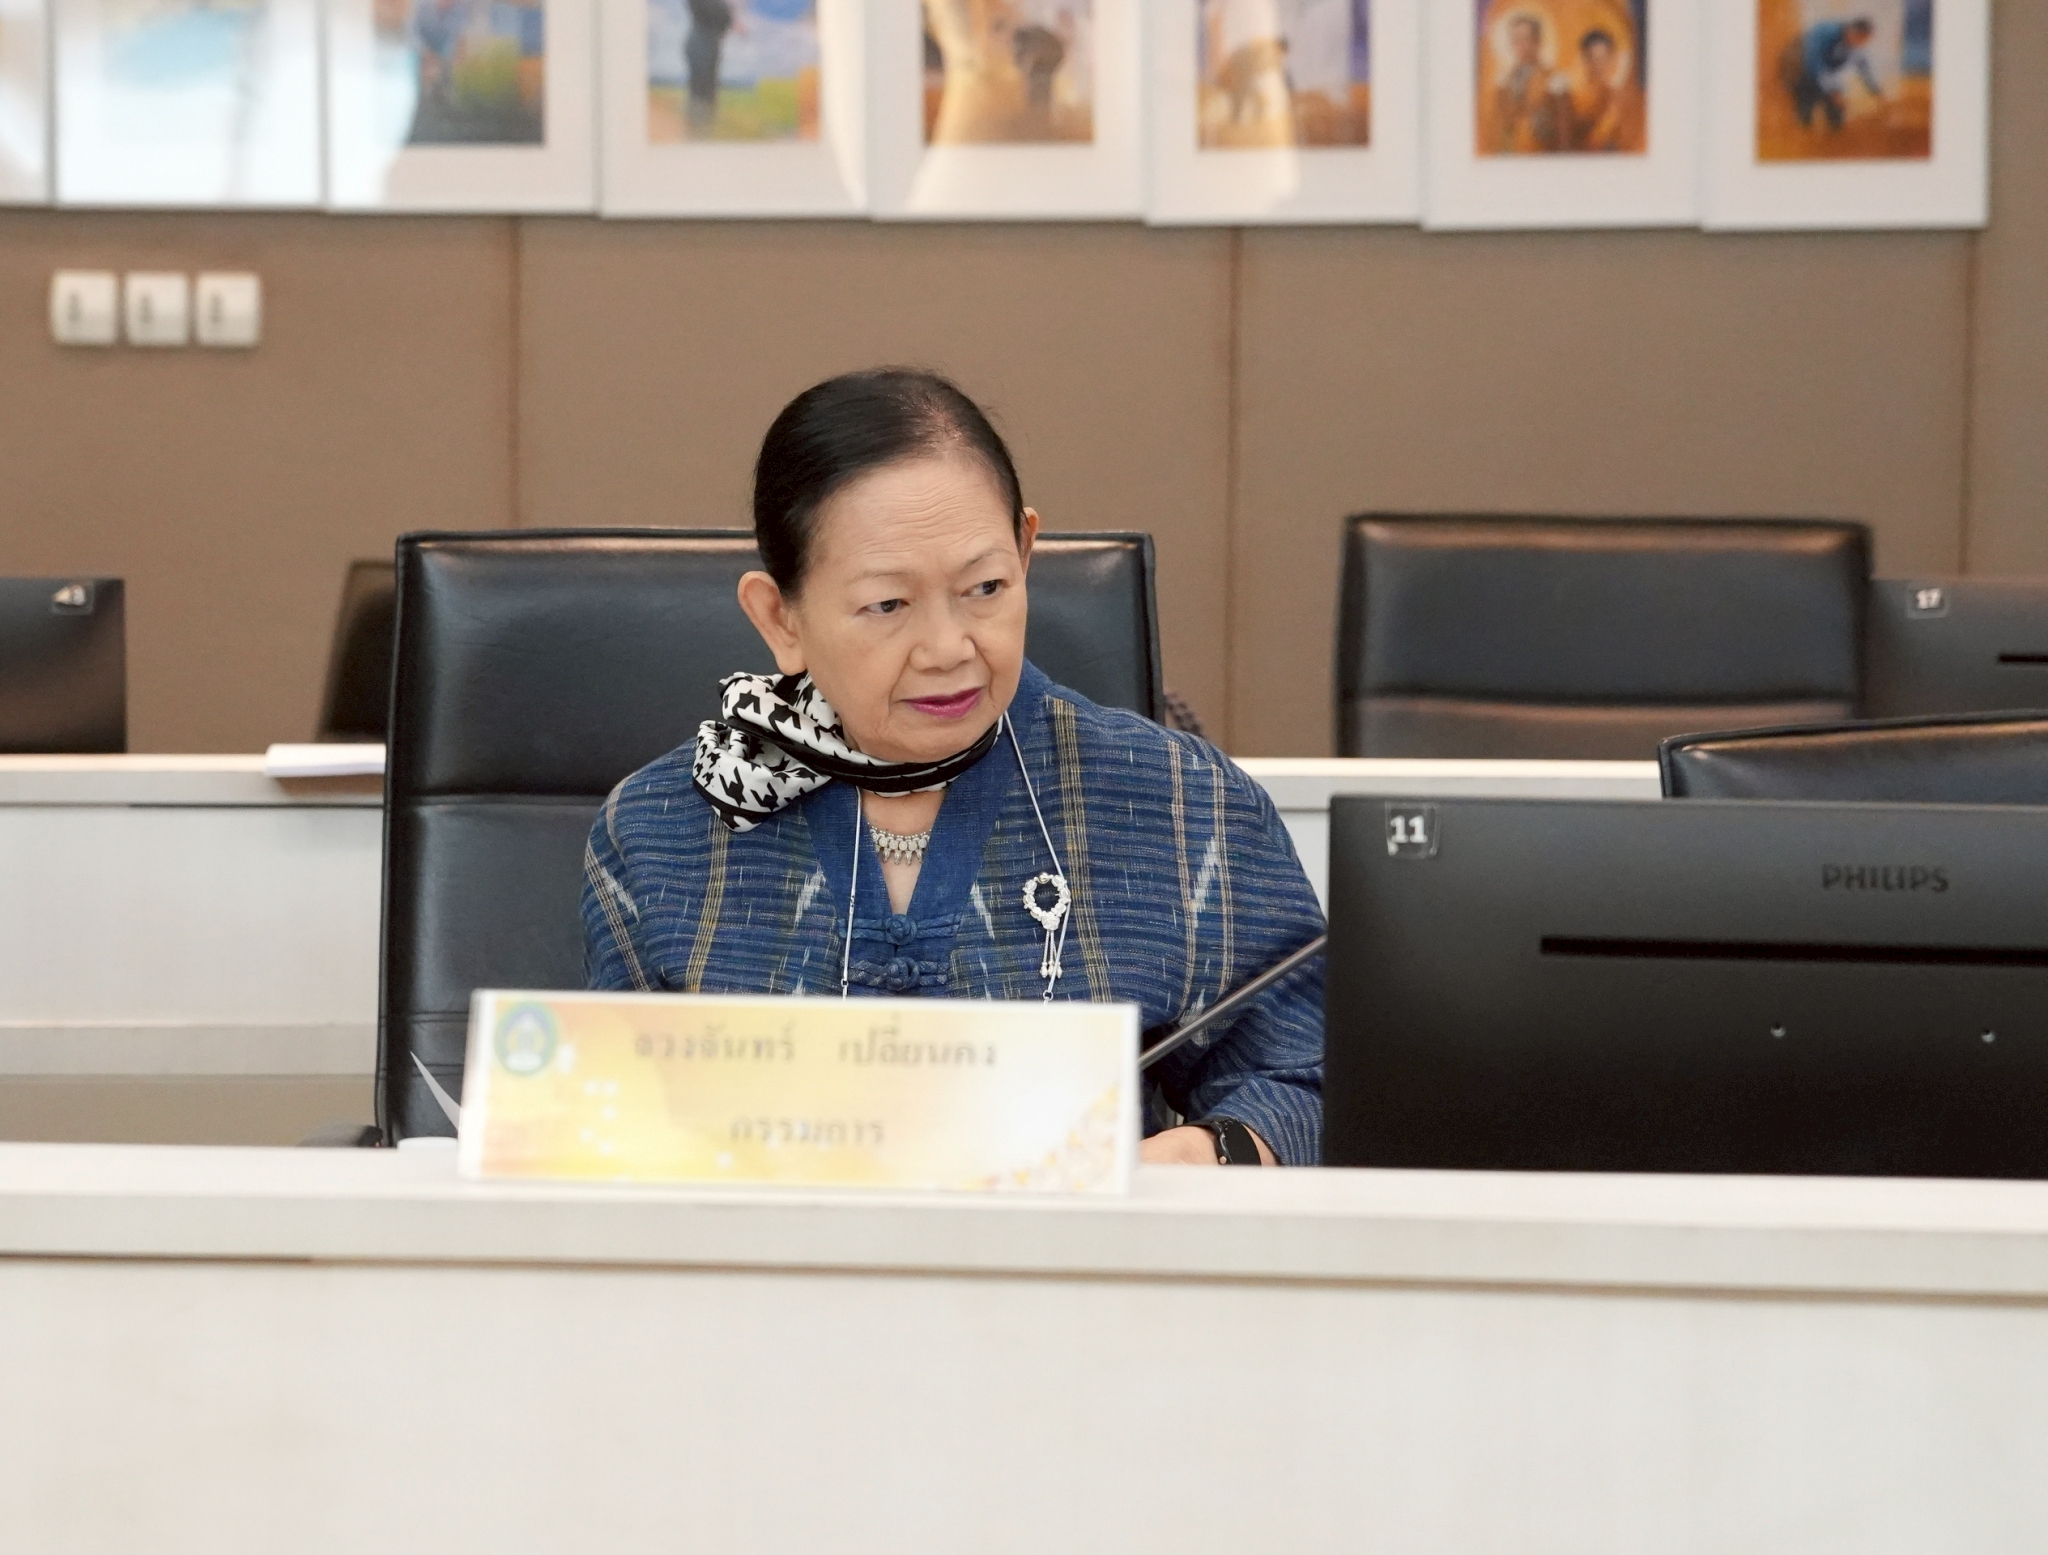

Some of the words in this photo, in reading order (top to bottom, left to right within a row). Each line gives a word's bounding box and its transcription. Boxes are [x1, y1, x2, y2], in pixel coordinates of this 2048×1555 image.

[1390, 815, 1428, 843] 11
[1821, 864, 1949, 892] PHILIPS
[730, 1115, 885, 1144] กรรมการ
